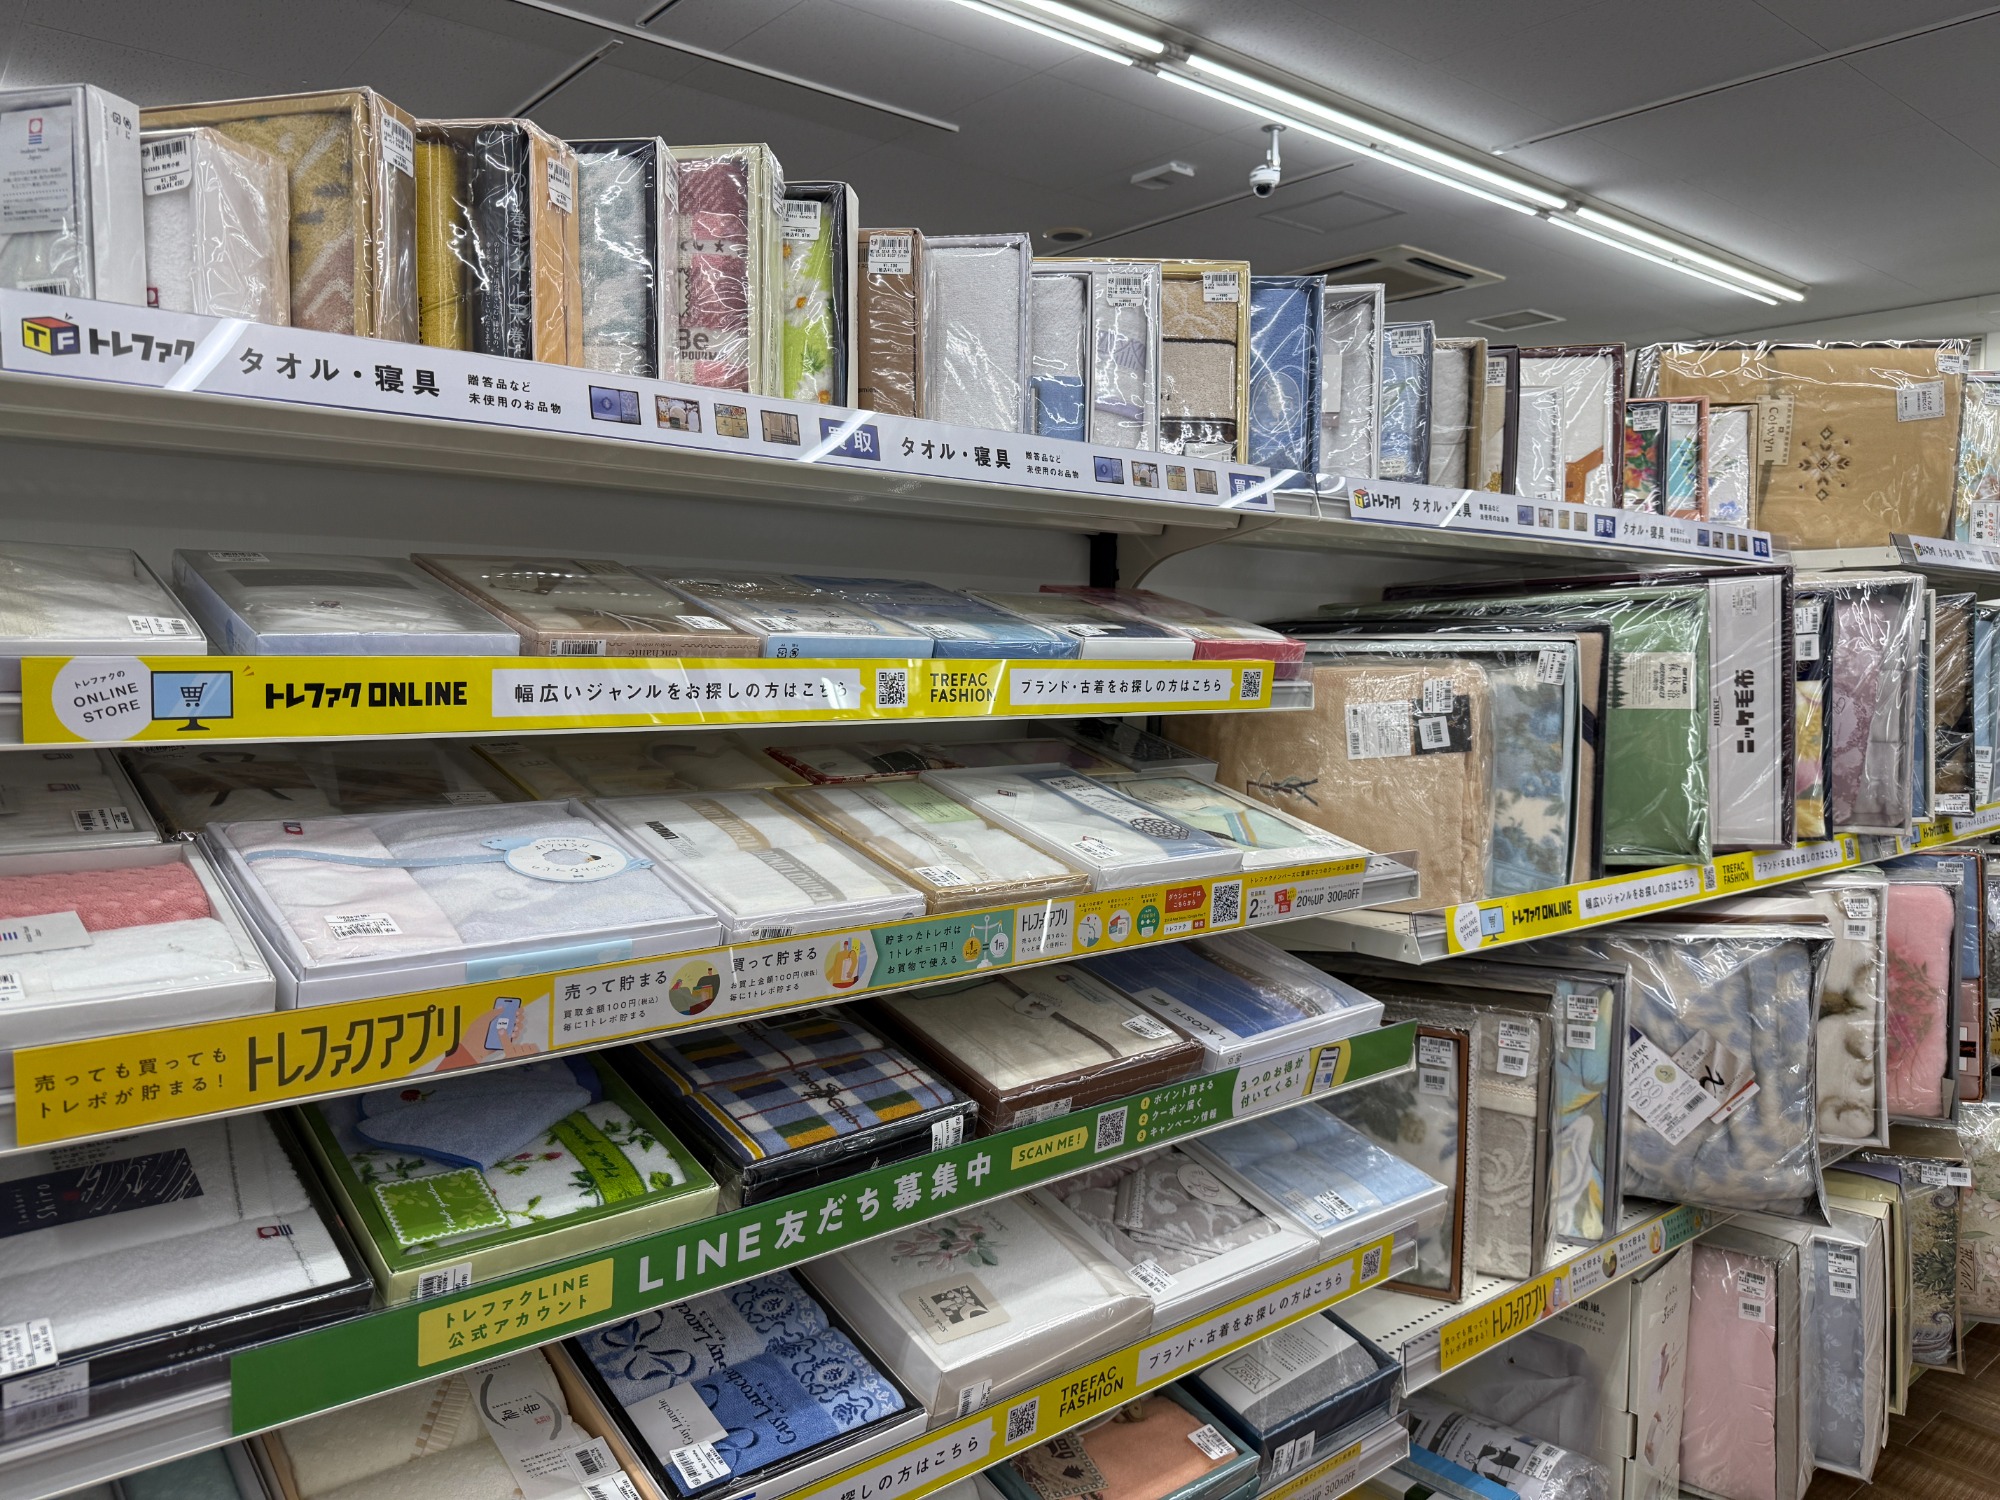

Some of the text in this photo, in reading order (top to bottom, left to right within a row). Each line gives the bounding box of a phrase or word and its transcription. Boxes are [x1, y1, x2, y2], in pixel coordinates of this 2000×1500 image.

[88, 328, 195, 365] トレファク
[239, 346, 441, 398] タオル・寝具
[467, 373, 531, 393] 贈答品など
[468, 391, 562, 415] 未使用のお品物
[1765, 406, 1779, 453] Colwyn
[901, 437, 1011, 470] タオル・寝具
[1025, 450, 1061, 465] 贈答品など
[1026, 465, 1080, 480] 未使用のお品物
[1596, 518, 1614, 534] 買取
[1623, 523, 1665, 540] タオル・寝具
[74, 669, 126, 690] トレファクの
[930, 672, 988, 687] TREFAC
[1021, 677, 1222, 695] ブランド・古着をお探しの方はこちら
[73, 682, 140, 709] ONLINE
[265, 681, 468, 710] トレファク ONLINE
[514, 680, 848, 704] 幅広いジャンルをお探しの方はこちら
[929, 687, 996, 703] FASHION
[83, 700, 141, 724] STORE
[1734, 669, 1755, 753] ニッケ毛布
[1722, 861, 1745, 874] TREFAC
[1723, 871, 1750, 885] FASHION
[1168, 891, 1201, 900] ダウンロードは
[1296, 893, 1324, 909] 20%UP
[1585, 877, 1695, 911] 幅広いジャンルをお探しの方はこちら
[1249, 899, 1259, 919] 2
[1512, 900, 1572, 926] トレファク ONLINE
[885, 925, 962, 946] 貯まったトレポは
[1165, 924, 1187, 932] トレファク
[1459, 917, 1478, 934] ONLINE
[1463, 926, 1480, 942] STORE
[732, 946, 818, 972] 買って貯まる
[887, 955, 958, 975] お買物で使える
[564, 969, 668, 1001] 売って貯まる
[563, 995, 659, 1019] 買取金額100円(税込)
[563, 1009, 647, 1032] 毎に1トレポ貯まる
[248, 1004, 461, 1092] トレファクアプリ
[34, 1048, 227, 1093] 売っても買っても
[1240, 1055, 1305, 1092] 3つのお得が
[41, 1073, 223, 1119] トレポが貯まる！
[1153, 1079, 1214, 1106] ポイント貯まる
[1240, 1073, 1302, 1109] 付いてくる！
[1152, 1098, 1202, 1122] クーポン届く
[1150, 1108, 1218, 1137] キャンペーン情報
[1018, 1142, 1054, 1163] SCAN
[1618, 1233, 1646, 1251] 買って貯まる
[1571, 1255, 1602, 1276] 売って貯まる
[446, 1273, 590, 1329] トレファクLINE
[1492, 1283, 1547, 1338] トレファクアプリ
[448, 1294, 587, 1350] 公式アカウント
[1149, 1272, 1342, 1377] ブランド・古着をお探しの方はこちら
[1444, 1316, 1489, 1346] 売っても買っても
[1061, 1366, 1117, 1400] TREFAC
[726, 1369, 797, 1446] Guy Laroche
[1059, 1377, 1124, 1417] FASHION
[659, 1397, 694, 1446] Guy Laroche
